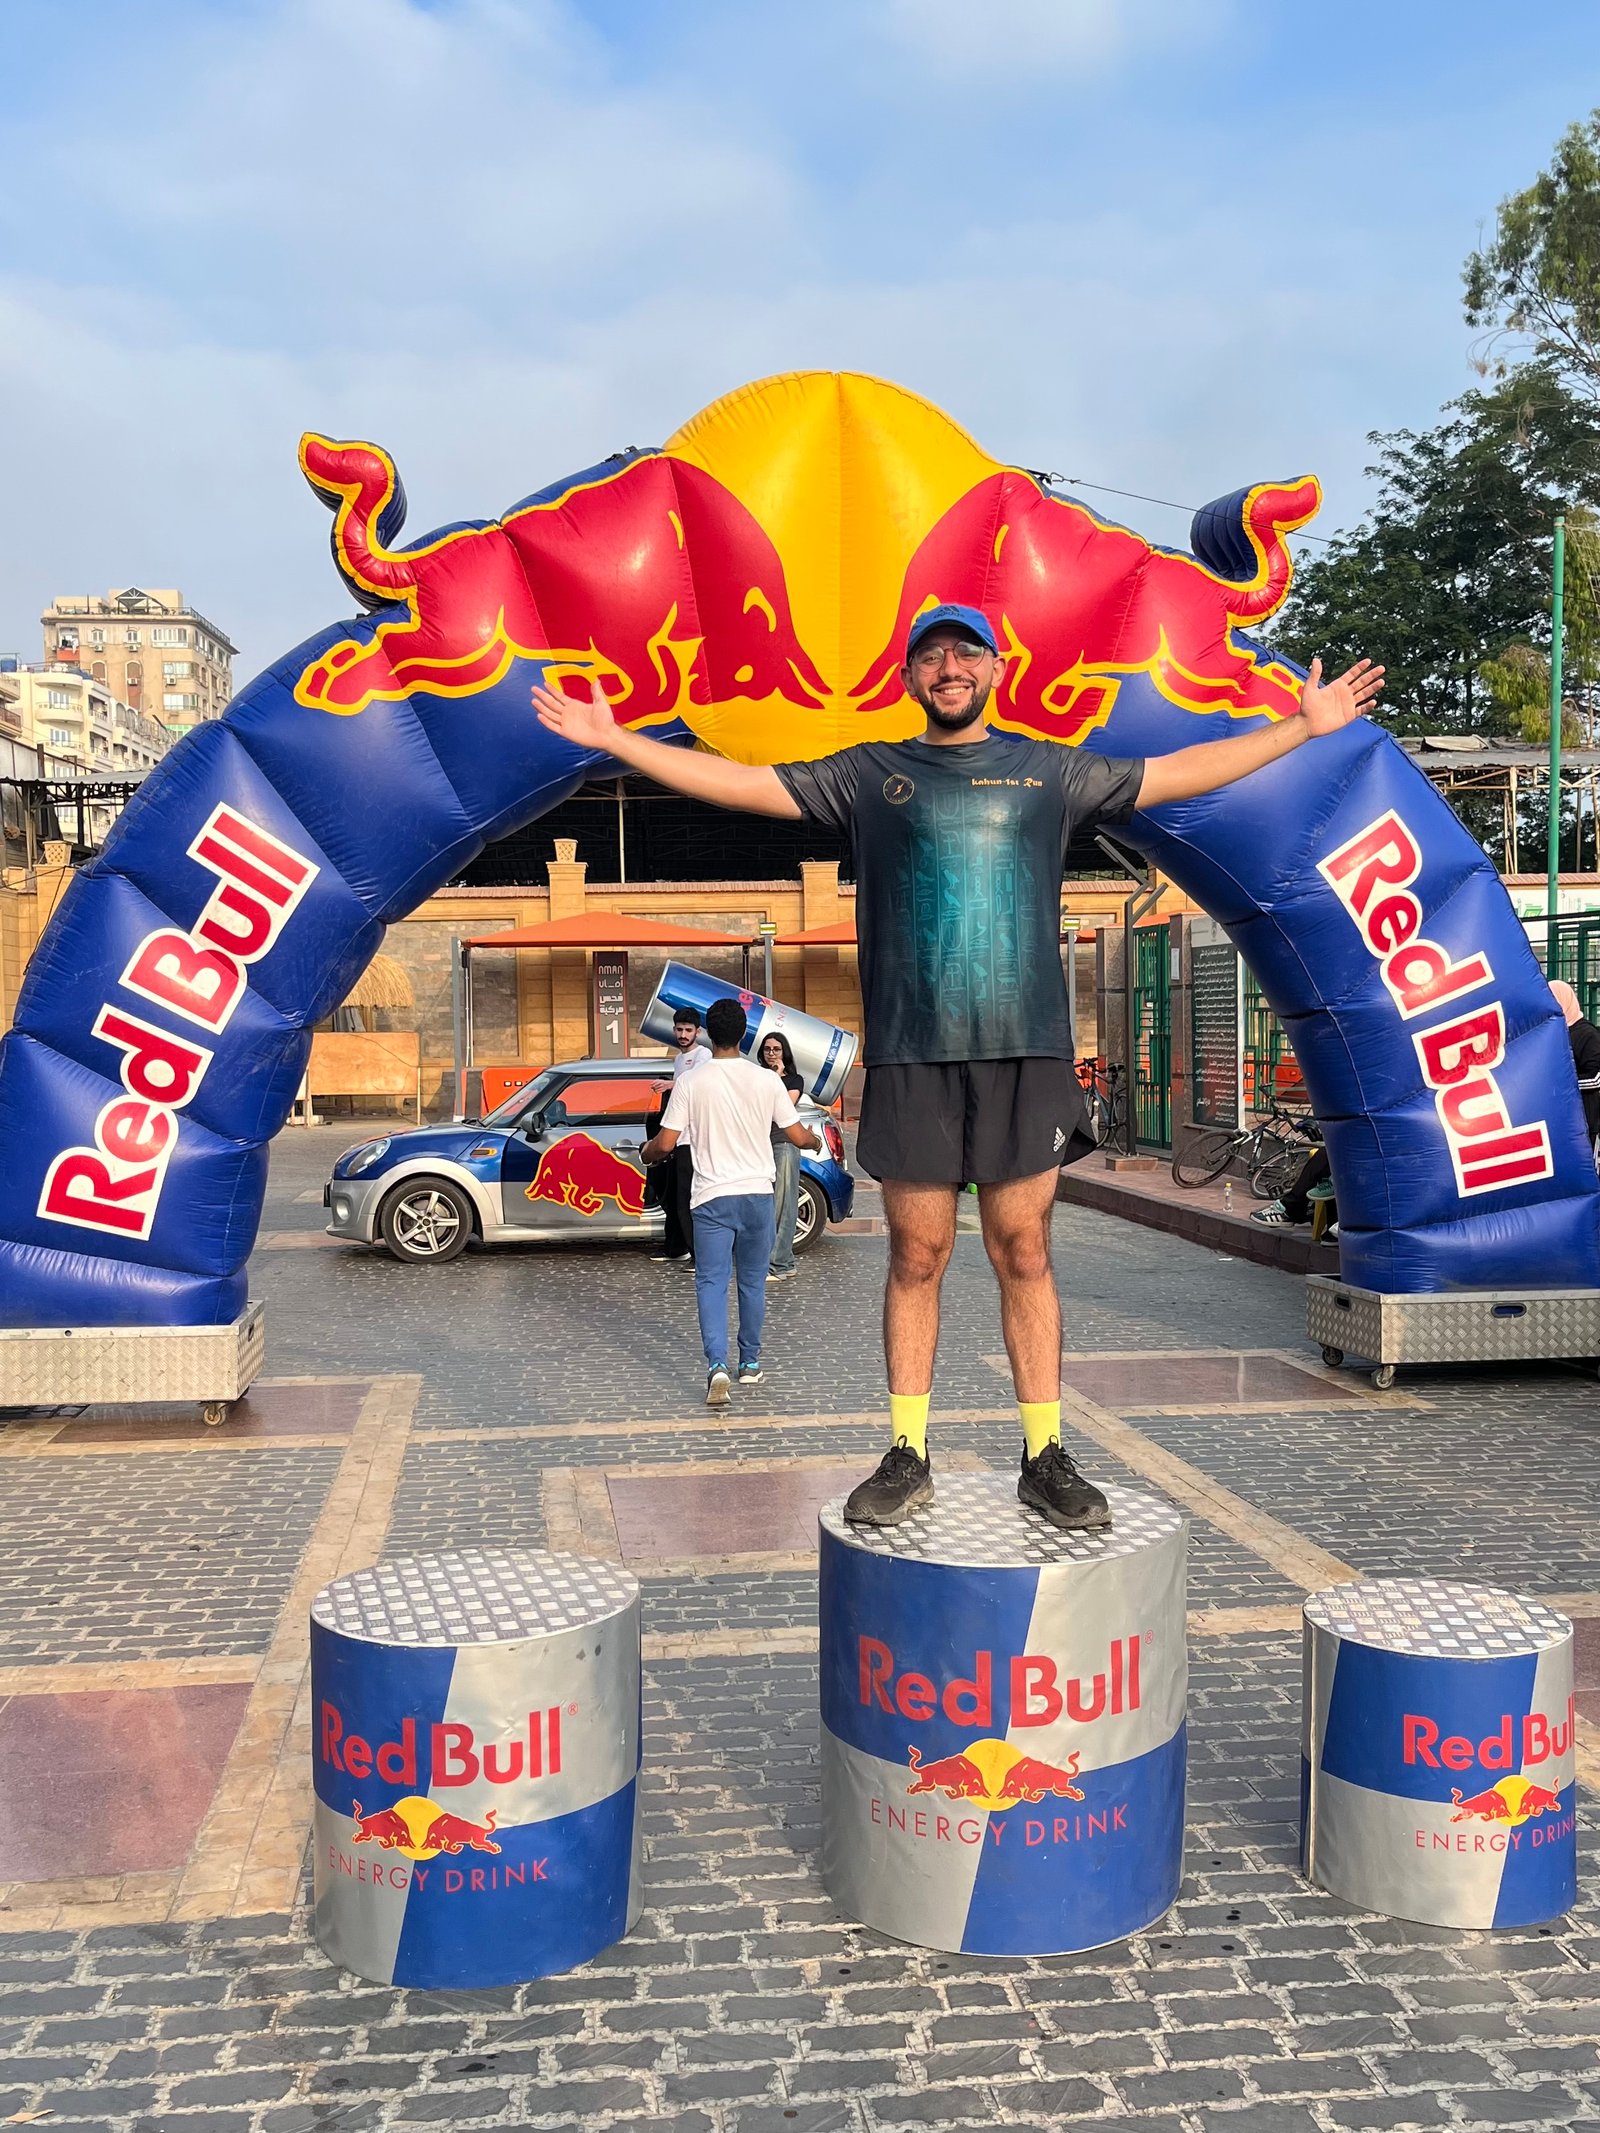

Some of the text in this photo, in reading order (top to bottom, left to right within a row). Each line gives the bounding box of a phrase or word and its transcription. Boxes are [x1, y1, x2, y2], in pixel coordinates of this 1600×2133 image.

[1023, 777, 1043, 788] Run
[44, 810, 311, 1232] Red Bull
[599, 1004, 624, 1016] مركبة
[600, 993, 624, 1004] فحص
[1325, 817, 1548, 1190] Red Bull
[606, 1019, 619, 1044] 1
[858, 1634, 1141, 1728] Red Bull
[321, 1700, 561, 1788] Red Bull
[1403, 1714, 1513, 1770] Red
[871, 1799, 1128, 1846] ENERGY DRINK
[1415, 1830, 1523, 1852] ENERGY
[330, 1846, 550, 1894] ENERGY DRINK
